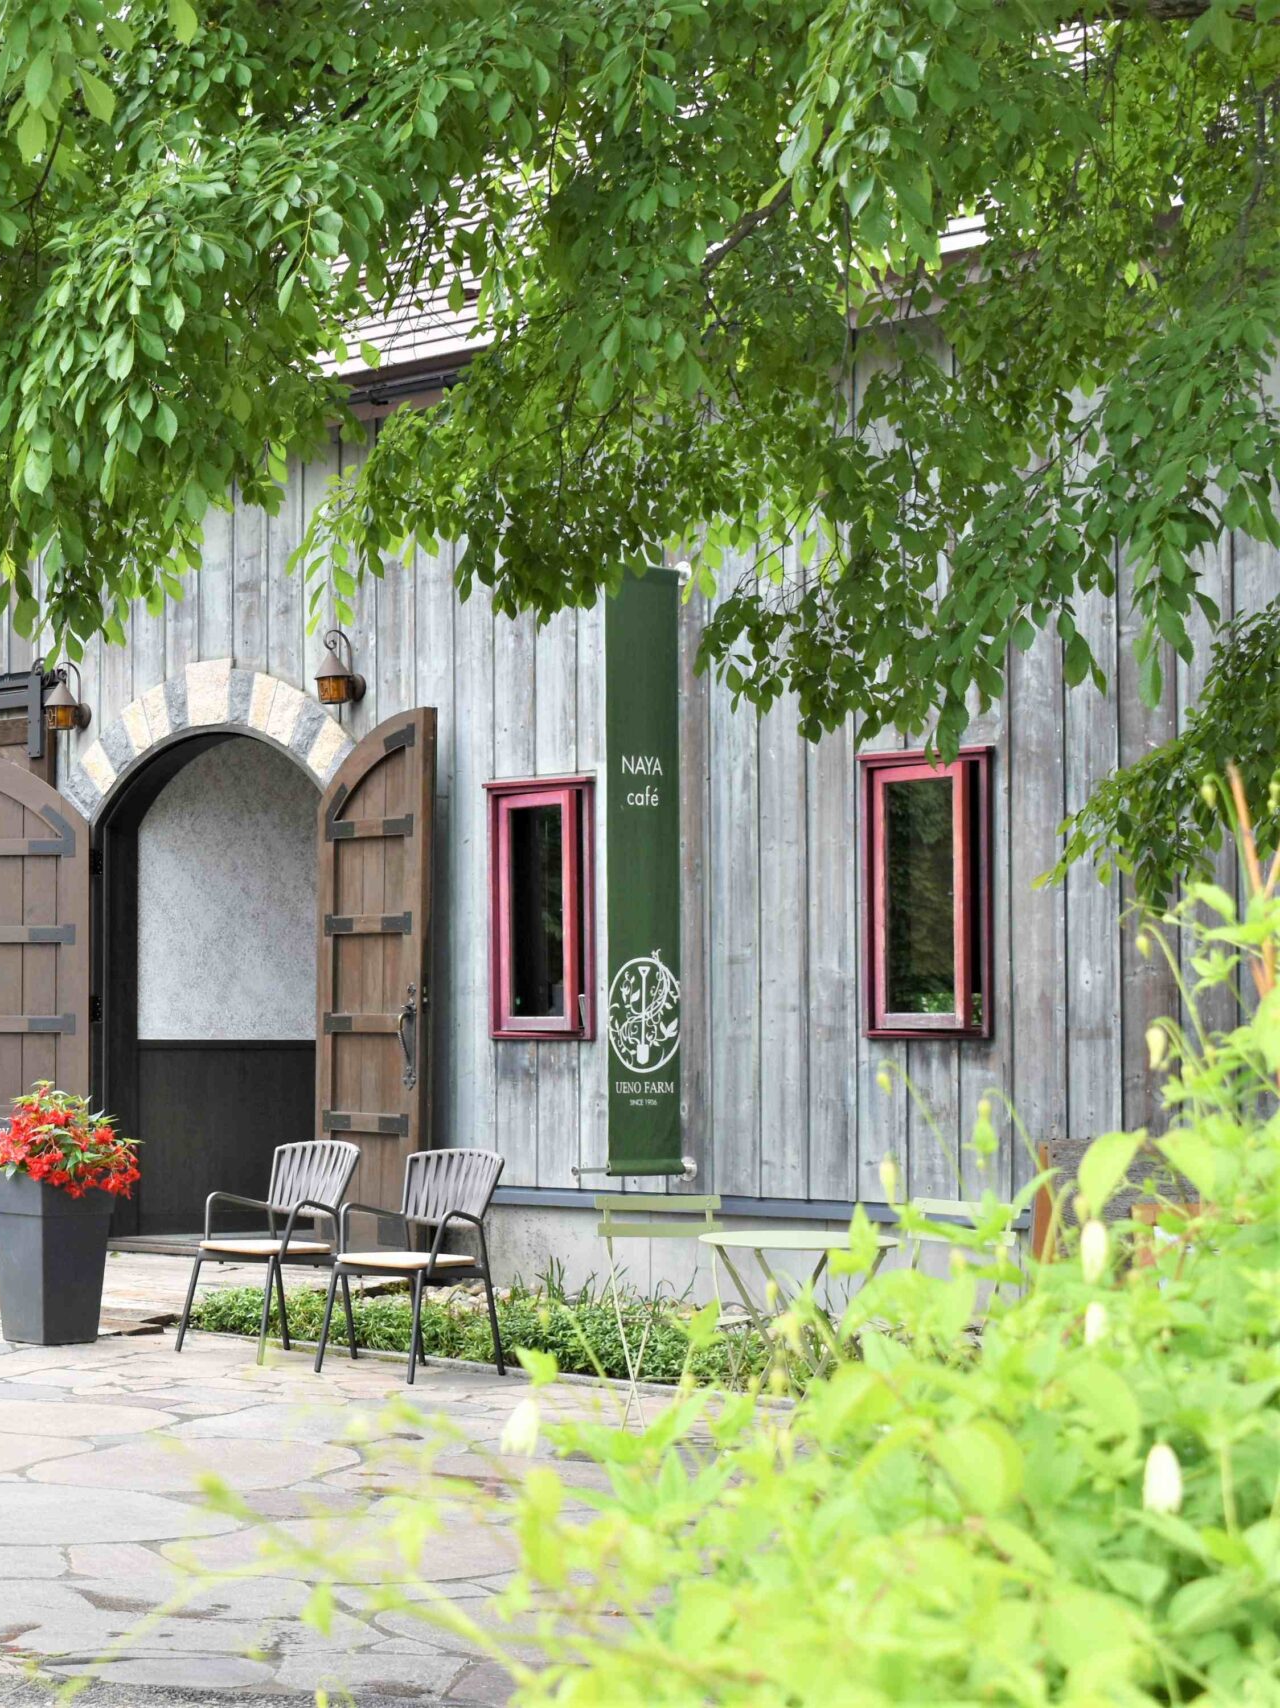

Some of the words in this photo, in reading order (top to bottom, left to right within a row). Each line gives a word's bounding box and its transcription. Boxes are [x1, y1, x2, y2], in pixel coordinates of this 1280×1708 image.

[621, 755, 664, 776] NAYA
[626, 785, 659, 807] café
[615, 1081, 642, 1094] UENO
[644, 1081, 674, 1094] FARM
